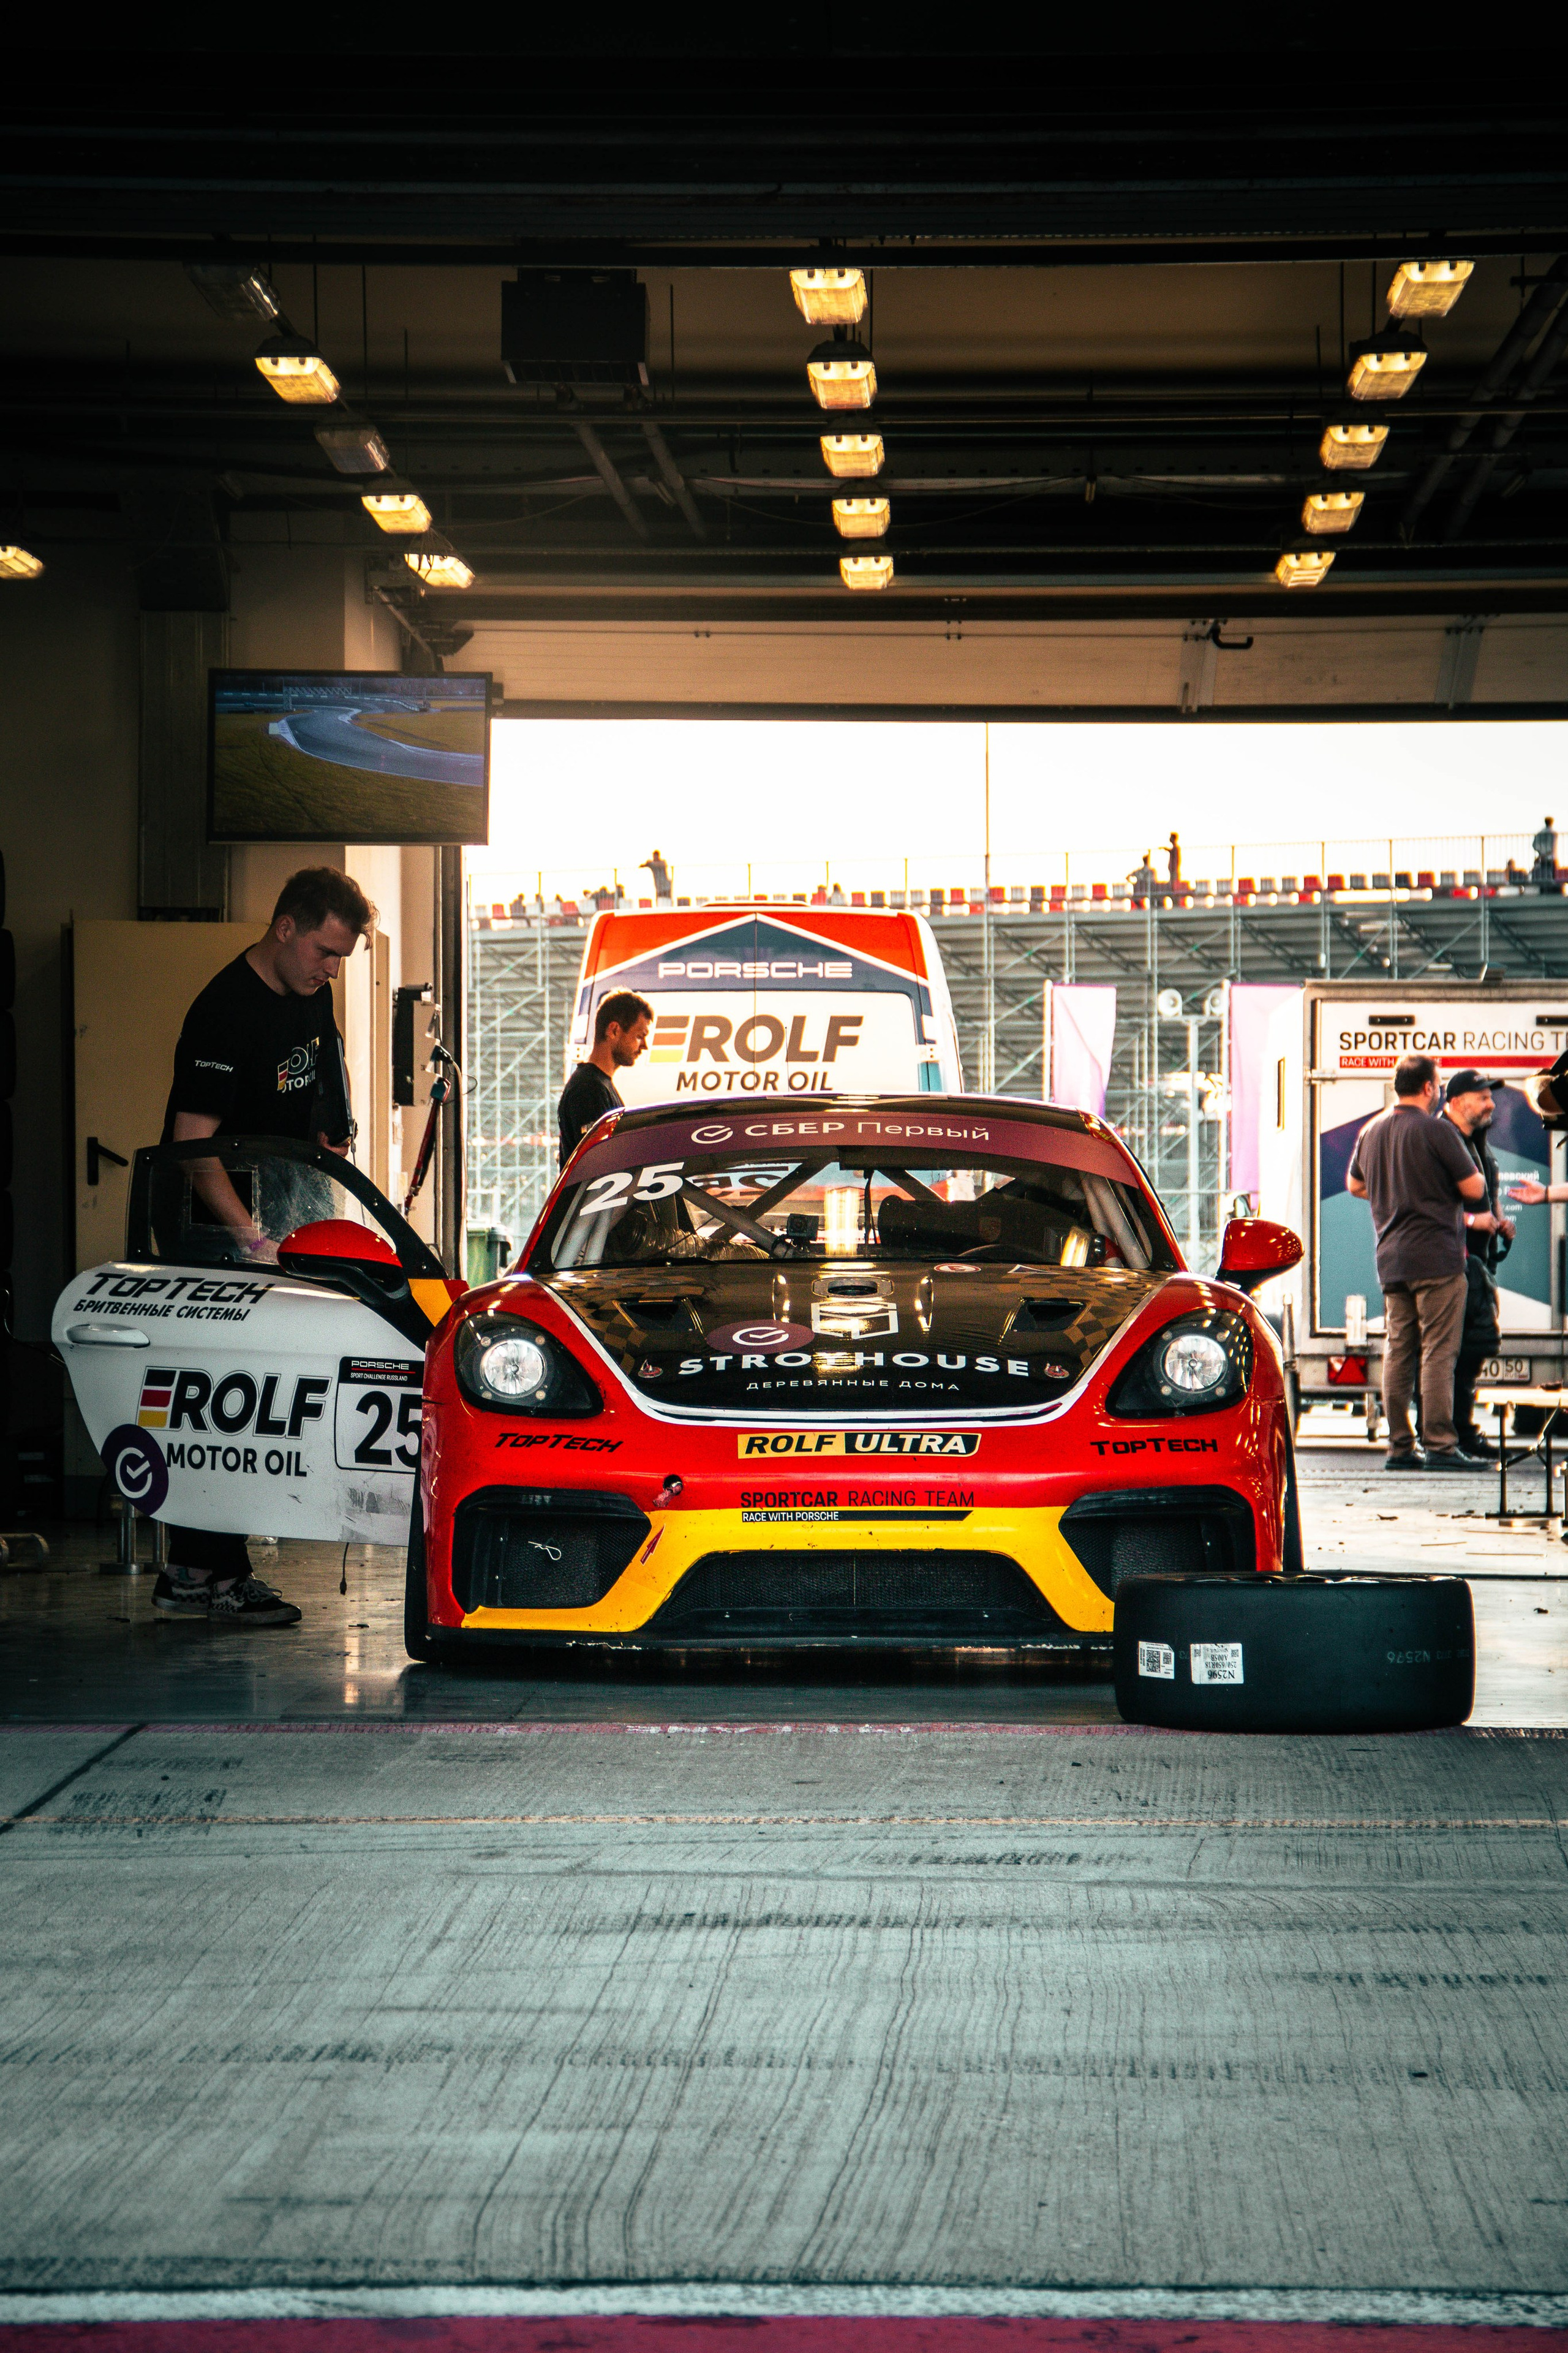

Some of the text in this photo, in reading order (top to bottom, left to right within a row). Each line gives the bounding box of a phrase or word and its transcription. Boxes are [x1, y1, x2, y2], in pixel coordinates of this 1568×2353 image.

[658, 962, 853, 979] PORSCHE
[687, 1014, 864, 1063] ROLF
[1340, 1031, 1568, 1051] SPORTCAR RACING T
[194, 1059, 234, 1073] TOPTECH
[1341, 1057, 1395, 1068] RACE WITH
[676, 1071, 834, 1092] MOTOR OIL
[745, 1122, 990, 1141] СБЕР Первый
[579, 1161, 685, 1217] 25
[86, 1272, 275, 1304] TOPTECH
[73, 1299, 251, 1321] БРИТВЕННЫЕ СИСТЕМЫ
[351, 1360, 409, 1370] PORSCHE
[363, 1372, 386, 1381] CHALLENGE
[746, 1379, 960, 1391] ДЕРЕВЯННЫЕ ДОМА
[169, 1370, 330, 1438] ROLF
[354, 1390, 423, 1468] 25
[494, 1432, 624, 1453] TOPTECH
[745, 1433, 967, 1454] ROLF ULTRA
[1090, 1437, 1218, 1456] TOPTECH
[167, 1442, 307, 1478] MOTOR OIL
[741, 1490, 974, 1508] SPORTCAR RACING TEAM
[742, 1511, 839, 1522] RACE WITH PORSCHE
[1207, 1670, 1235, 1680] N2596
